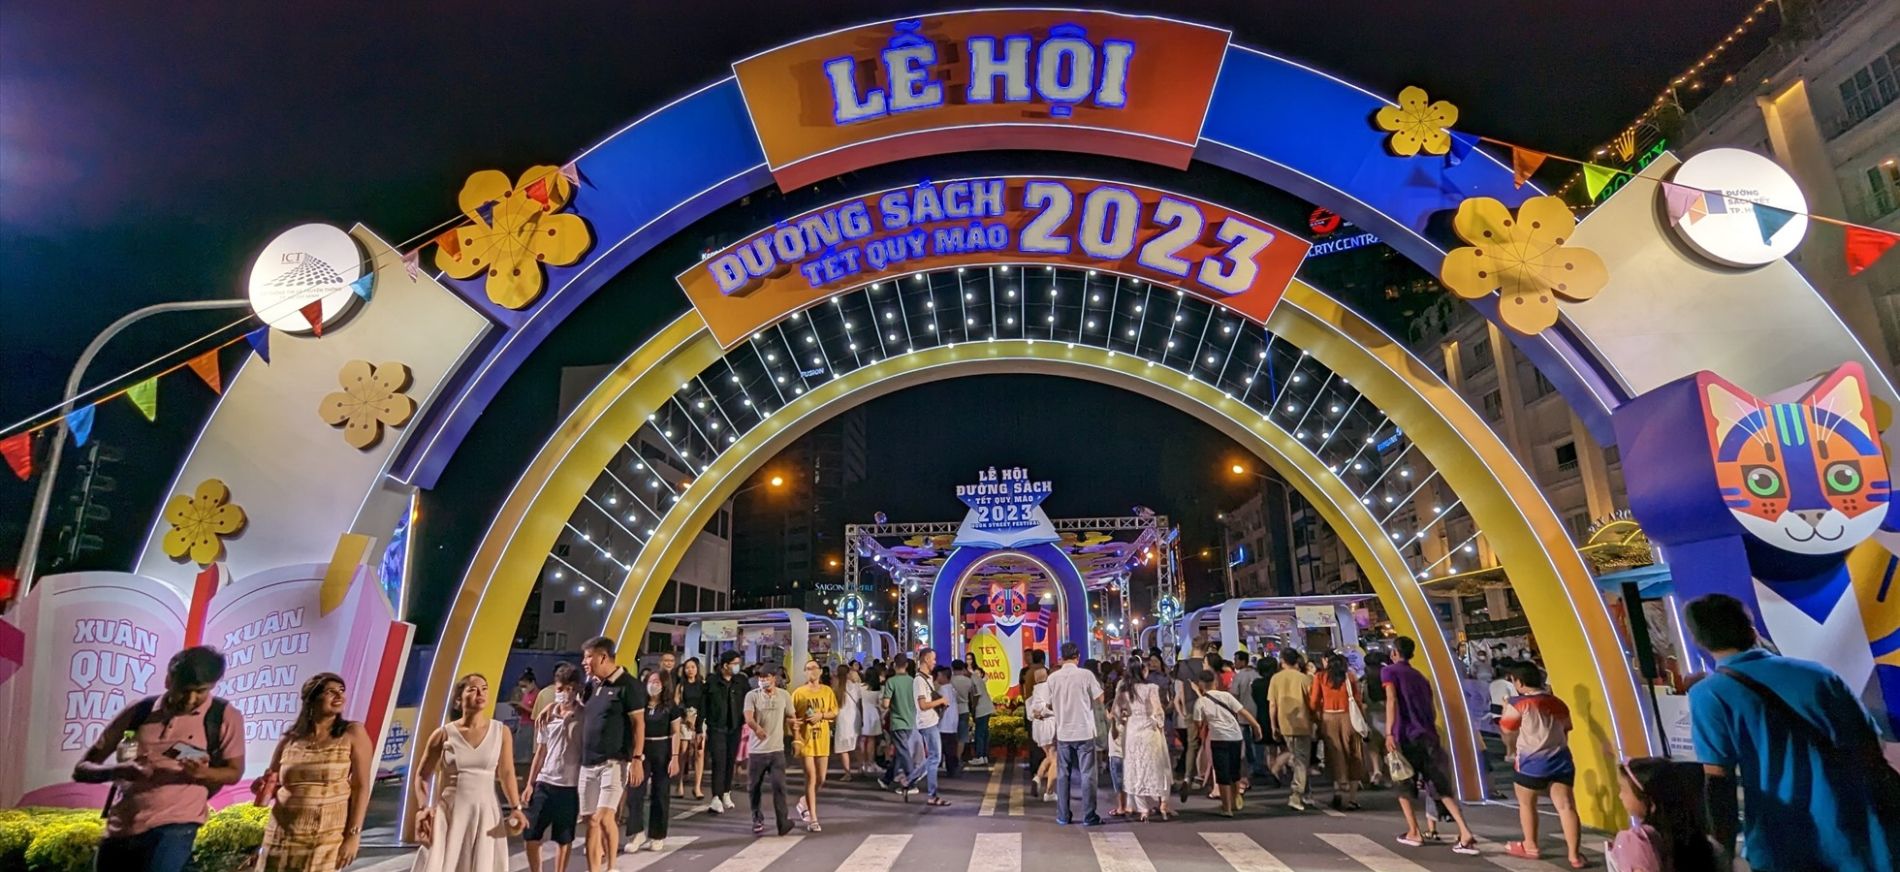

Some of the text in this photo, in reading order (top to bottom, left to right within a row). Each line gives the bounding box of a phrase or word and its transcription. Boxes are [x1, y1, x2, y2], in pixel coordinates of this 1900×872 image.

[824, 19, 1135, 125] LỄ HỘI
[707, 179, 1006, 296] ĐƯỜNG SÁCH
[1018, 180, 1276, 297] 2023
[1335, 233, 1379, 251] CENTR
[281, 252, 303, 262] ICT
[800, 221, 1009, 289] TẾT QUÝ MÃO
[956, 480, 1052, 496] ĐƯỜNG SÁCH
[978, 466, 1028, 482] LỄ HỘI
[978, 504, 1034, 523] 2023
[815, 583, 845, 591] SAIGON
[73, 618, 159, 657] XUÂN
[223, 606, 304, 650] XUÂN
[225, 632, 311, 669] N VUI
[69, 649, 156, 694] QUÝ
[216, 665, 298, 698] XUÂN
[65, 687, 127, 721] MÃ
[230, 692, 298, 718] HỊNH
[61, 721, 106, 751] 20
[382, 742, 403, 755] 023
